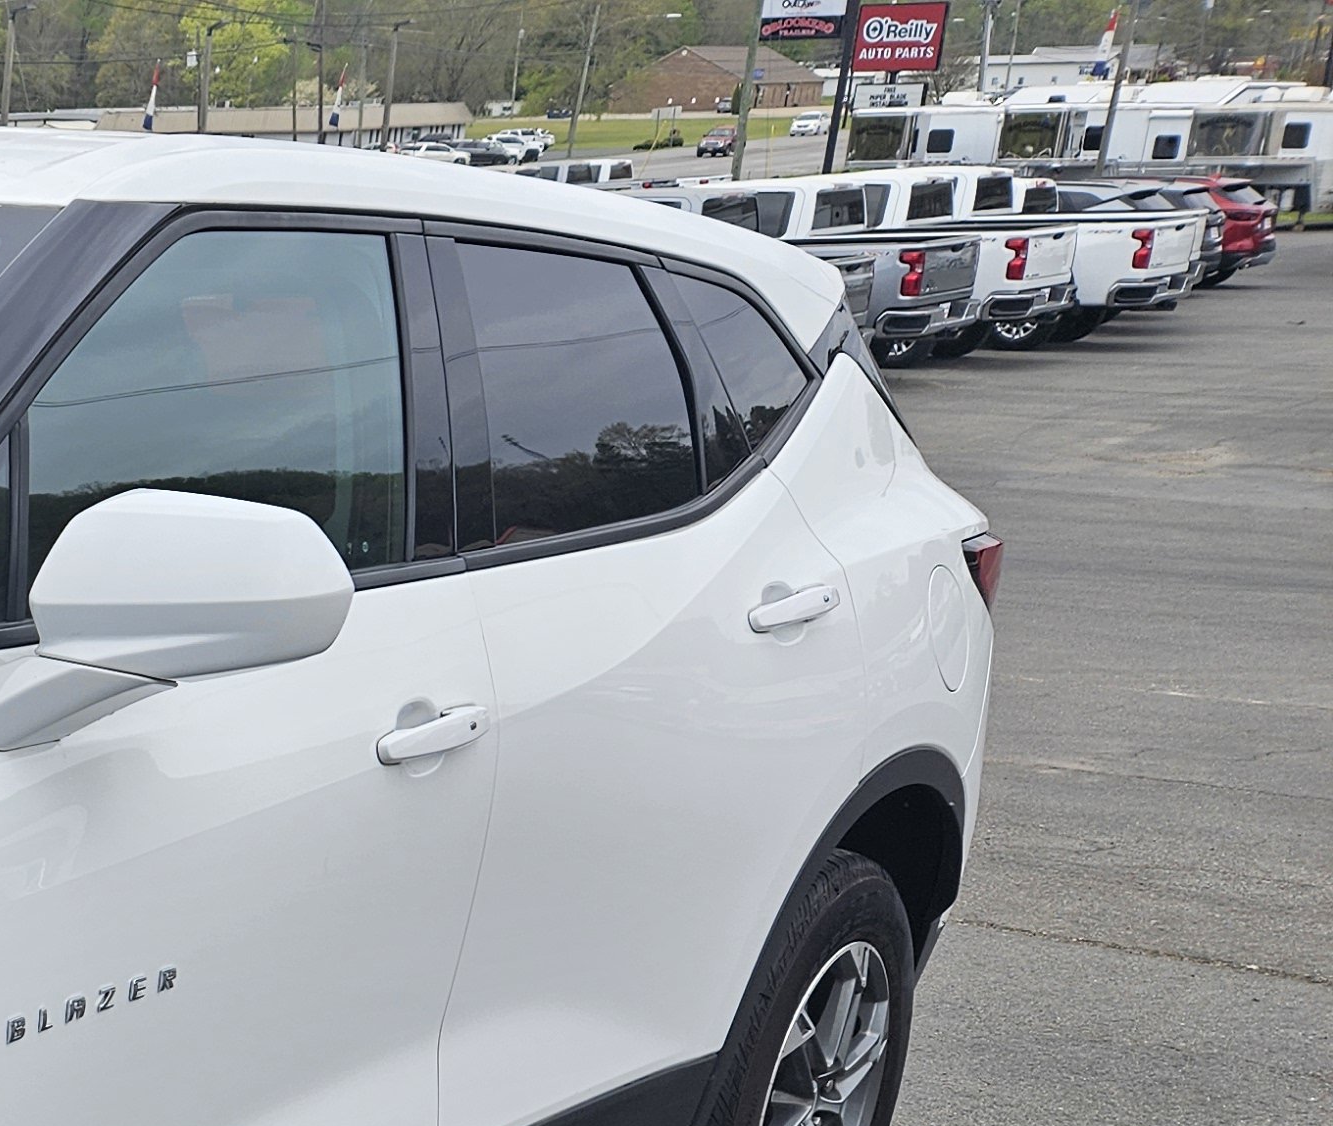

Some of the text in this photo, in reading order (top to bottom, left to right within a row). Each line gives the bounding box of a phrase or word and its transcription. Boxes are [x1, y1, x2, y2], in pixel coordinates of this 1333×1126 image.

[865, 18, 935, 42] O'Reilly
[858, 46, 935, 59] AUTO PARTS
[6, 964, 178, 1045] BLAZER
